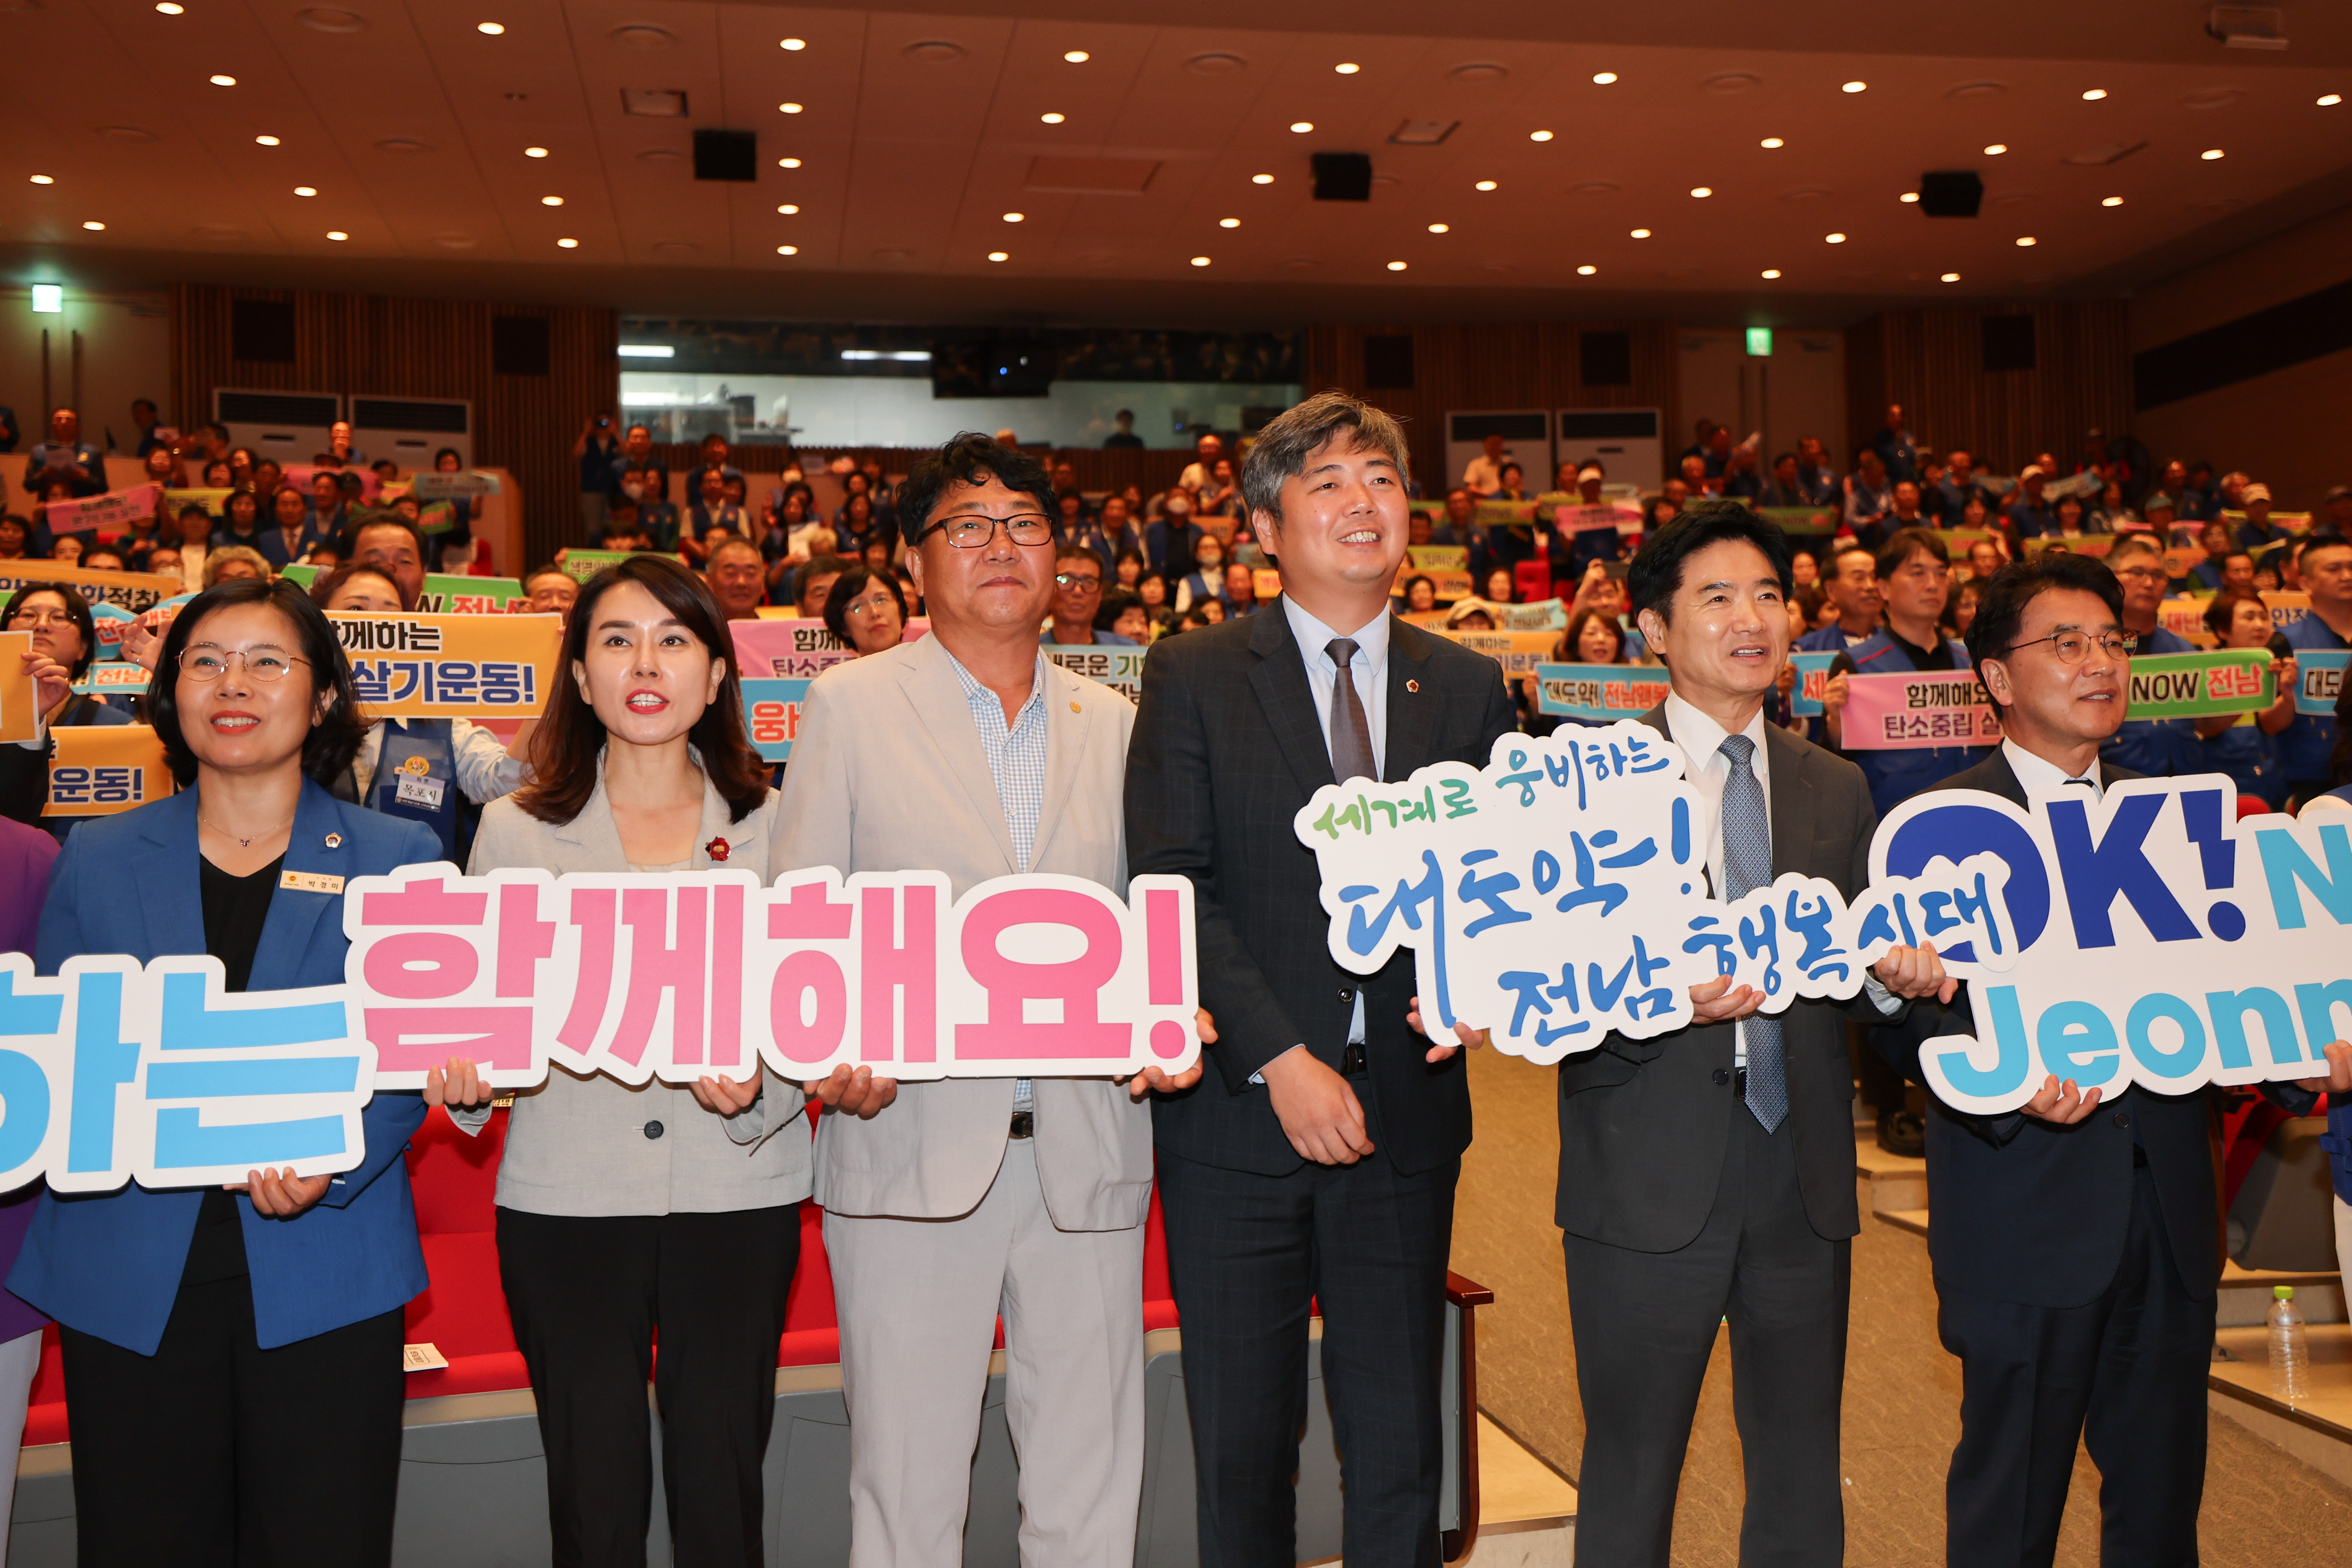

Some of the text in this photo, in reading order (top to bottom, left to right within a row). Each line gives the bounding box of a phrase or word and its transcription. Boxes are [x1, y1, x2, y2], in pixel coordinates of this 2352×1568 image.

[1544, 681, 1600, 707] 대도약!
[1884, 713, 1972, 739] 탄소중립
[2132, 665, 2261, 702] NOW 전남
[53, 768, 142, 802] 운동!
[1313, 736, 1669, 840] 세계로 웅비하는
[1339, 797, 1692, 1028] 대도약!
[1886, 789, 2246, 963] OK!
[362, 878, 1186, 1072] 함께해요!
[1498, 935, 1676, 1047] 전남
